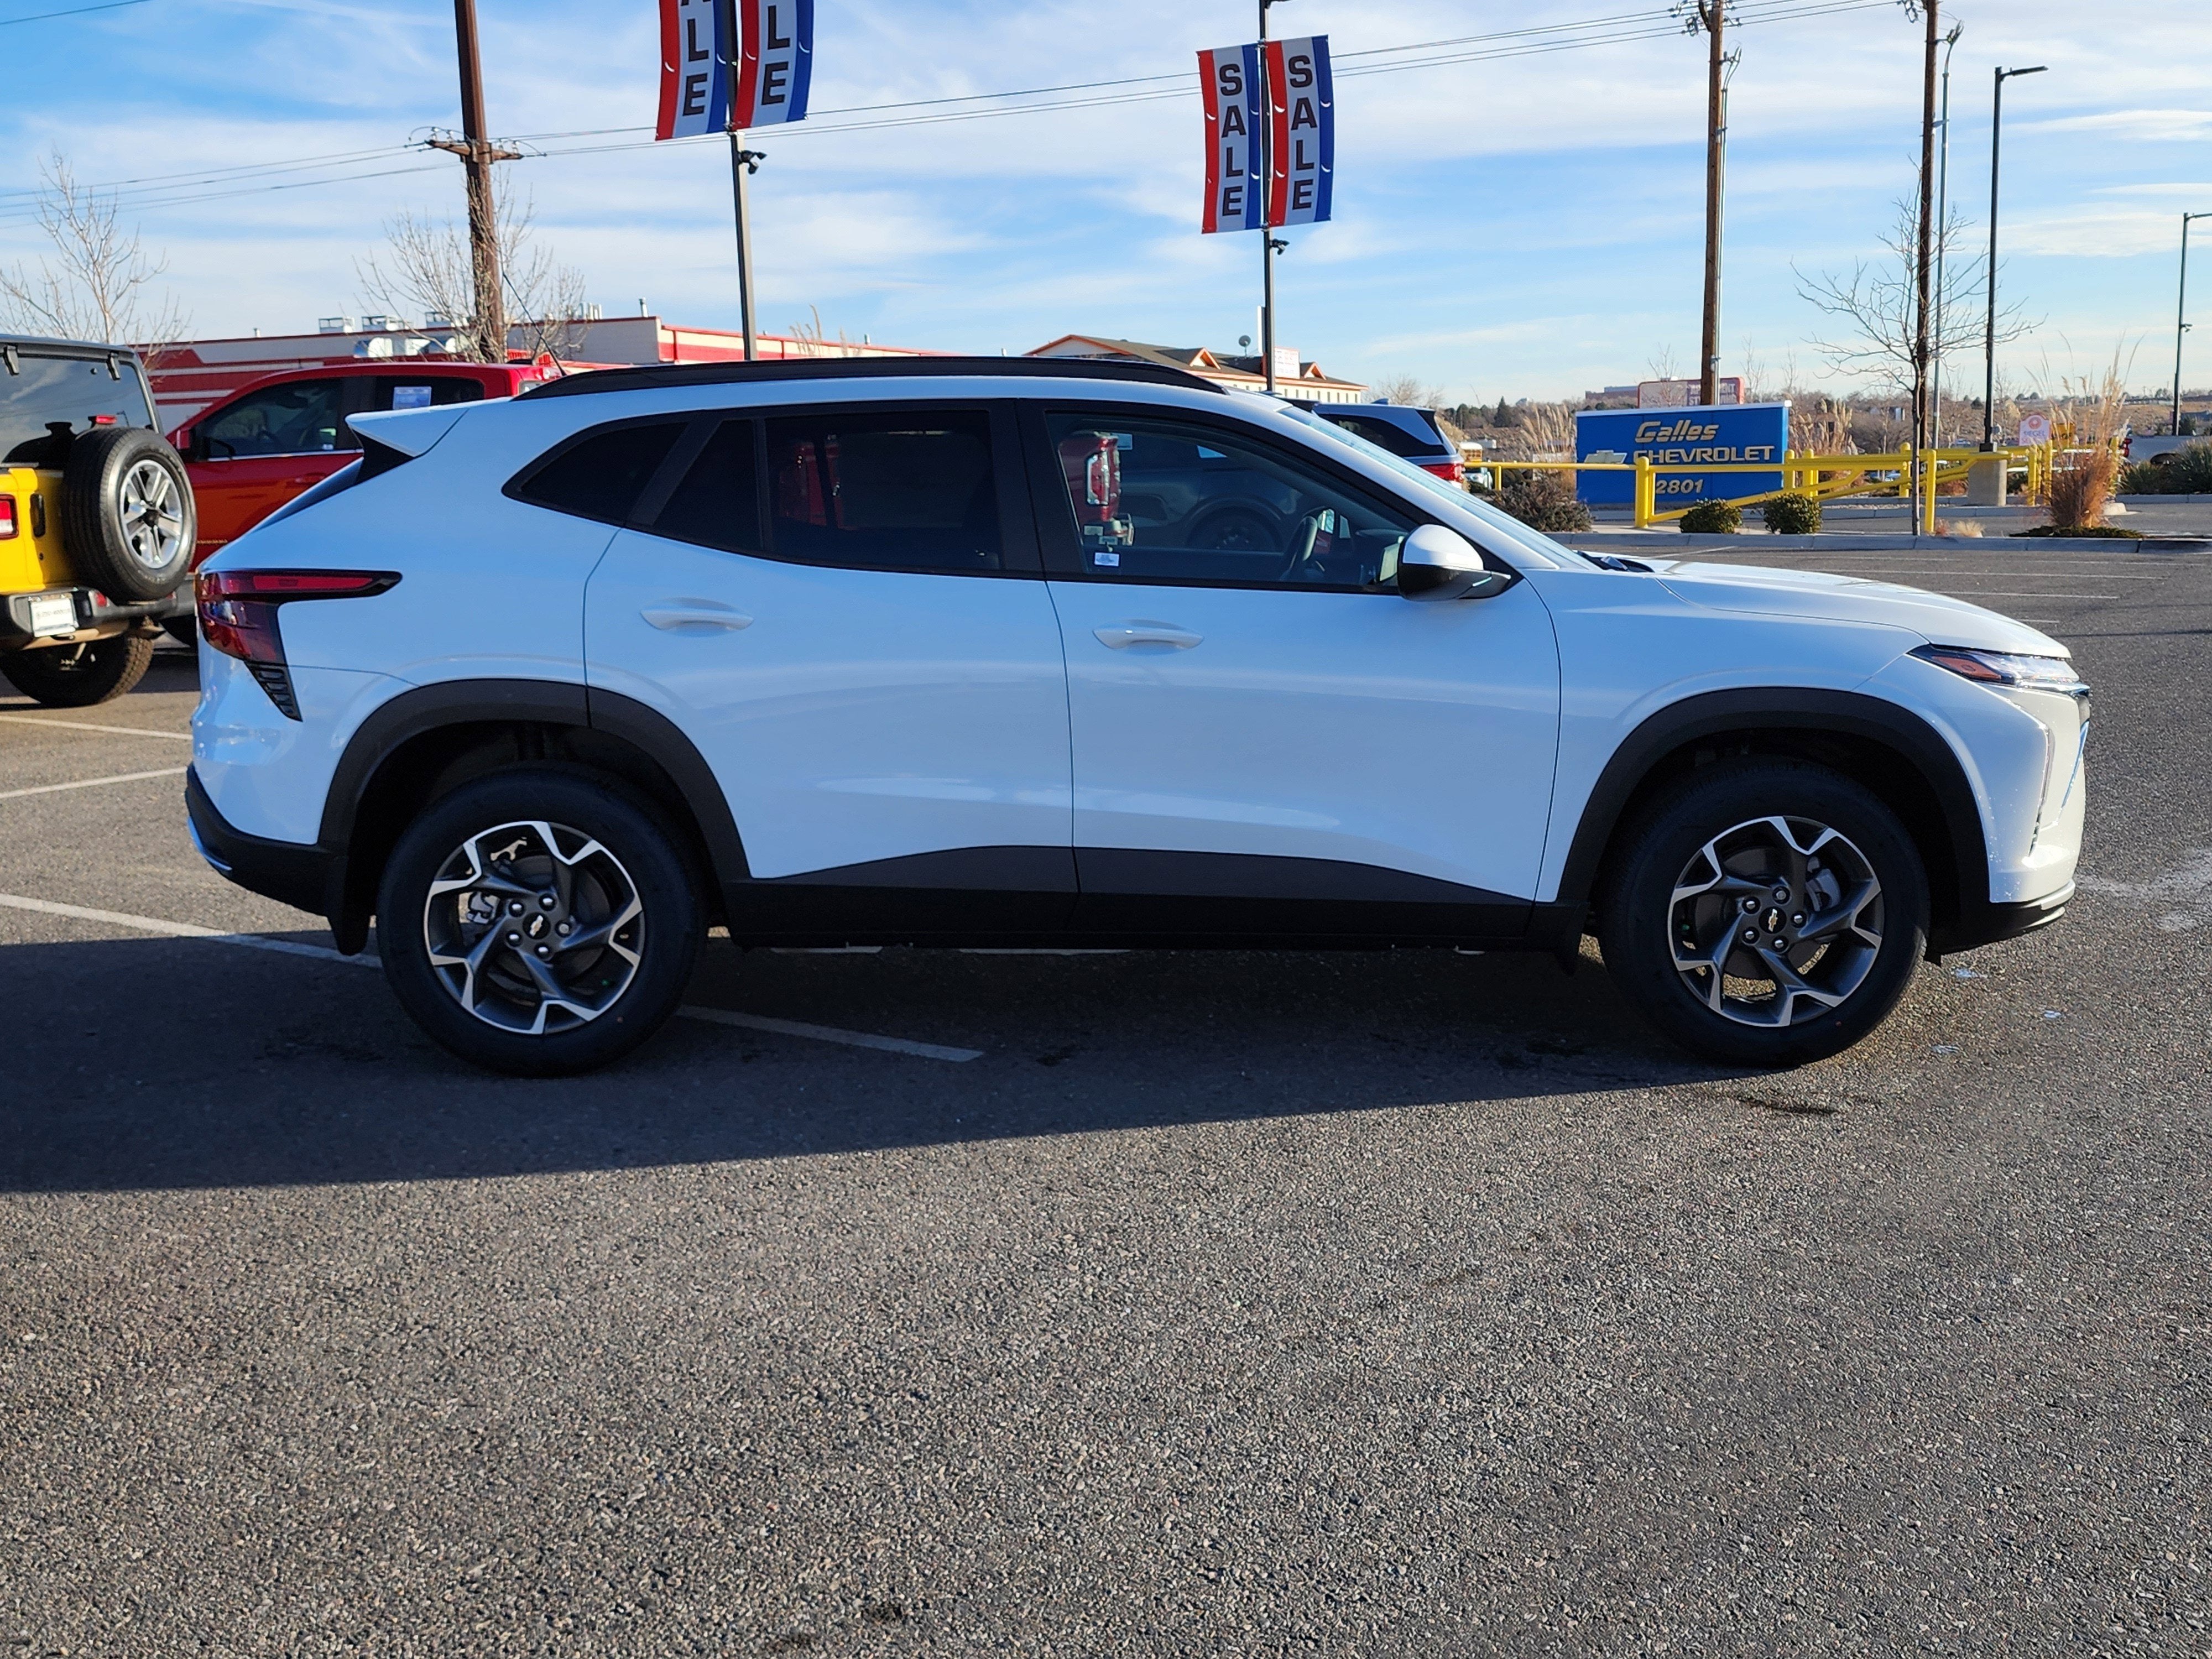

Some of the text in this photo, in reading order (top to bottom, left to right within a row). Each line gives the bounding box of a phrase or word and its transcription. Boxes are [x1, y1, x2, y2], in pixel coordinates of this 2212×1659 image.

[681, 0, 711, 116] LE
[1219, 64, 1246, 216] SALE
[1288, 55, 1317, 210] SALE
[1635, 420, 1719, 443] Galles
[1655, 479, 1704, 494] 2801
